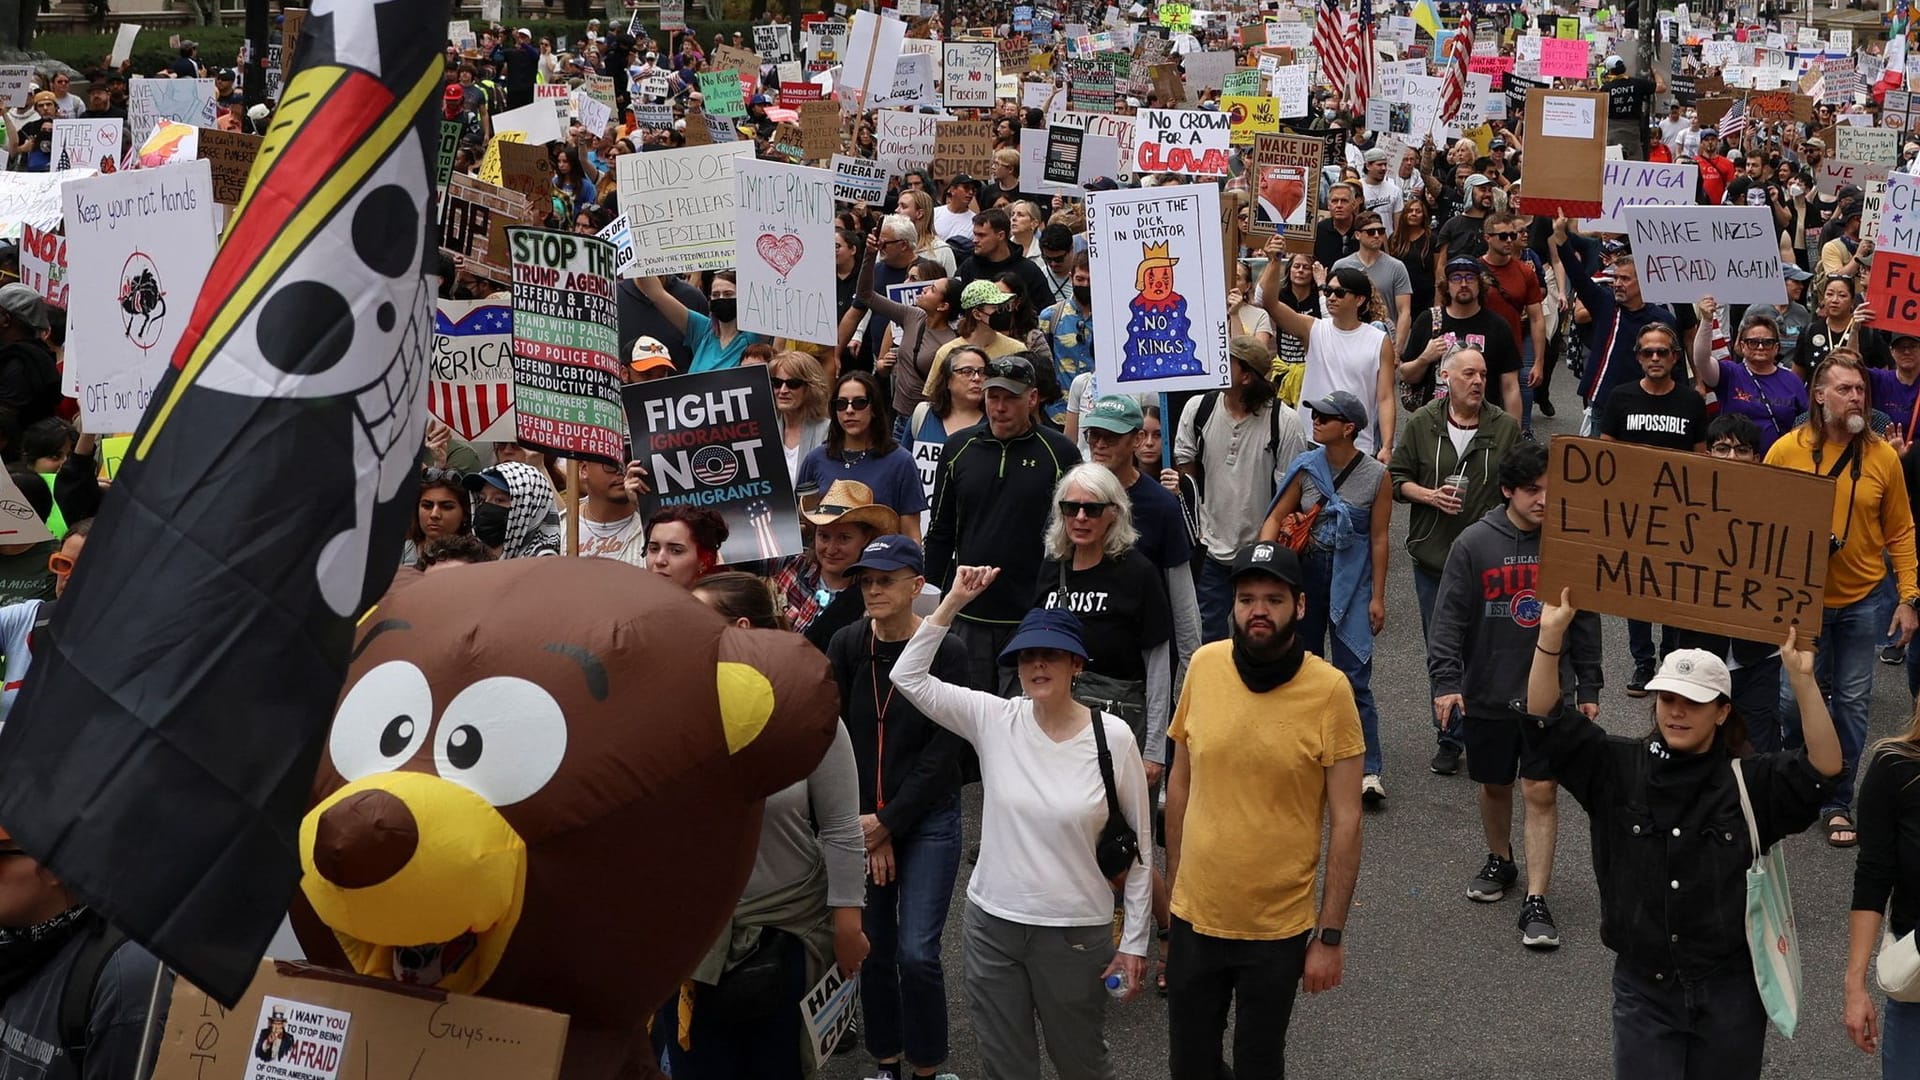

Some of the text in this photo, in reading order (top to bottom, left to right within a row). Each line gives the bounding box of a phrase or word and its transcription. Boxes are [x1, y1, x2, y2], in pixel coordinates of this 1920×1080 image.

[911, 44, 937, 54] HATE
[1073, 61, 1113, 70] STOP THE
[701, 71, 739, 87] No Kings
[947, 70, 992, 84] says NO to
[1224, 74, 1259, 89] CHICAGO
[537, 85, 568, 98] HATE
[783, 88, 821, 97] HANDS OFF
[949, 85, 988, 101] Fascism
[1611, 85, 1634, 96] DON'T
[133, 100, 150, 113] ME
[634, 105, 671, 113] HANDS OFF
[726, 101, 745, 113] 1776
[1257, 101, 1270, 115] NO
[637, 120, 673, 131] CHICAGO
[718, 121, 730, 132] DE
[883, 111, 917, 141] Keep
[1149, 111, 1231, 130] No CROWN
[56, 124, 92, 147] THE
[936, 123, 992, 138] DEMOCRACY
[1062, 134, 1081, 144] NATION
[1189, 130, 1203, 145] A
[1869, 130, 1887, 138] made
[938, 143, 986, 156] DIES IN
[1260, 138, 1319, 157] WAKE UP
[1856, 151, 1876, 161] ICE
[1053, 161, 1072, 171] UNDER
[1138, 141, 1230, 174] CLOWN
[1258, 153, 1319, 169] AMERICANS
[620, 156, 693, 195] HANDS
[837, 163, 887, 180] FUERA DE
[934, 160, 991, 177] SILENCE
[1048, 167, 1075, 178] DISTRESS
[1827, 165, 1855, 178] WE
[737, 170, 833, 226] IMMIGRANTS
[834, 184, 881, 203] CHICAGO
[77, 194, 102, 231] Keep
[108, 197, 135, 229] your
[161, 177, 197, 212] hands
[1109, 199, 1188, 218] YOU PUT THE
[759, 222, 799, 235] are the
[1087, 193, 1099, 259] JOKER
[1136, 216, 1164, 228] DICK
[1114, 224, 1185, 241] IN DICTATOR
[1636, 219, 1764, 245] MAKE NAZIS
[513, 231, 615, 282] STOP THE
[678, 263, 695, 273] THE
[1646, 253, 1780, 285] AFRAID AGAIN!
[513, 263, 616, 302] TRUMP AGENDA
[513, 283, 560, 304] DEFEND
[567, 293, 576, 306] &
[901, 287, 919, 306] ICE
[513, 297, 583, 320] IMMIGRANT
[744, 280, 833, 338] AMERICA
[514, 312, 575, 334] STAND WITH
[1144, 315, 1168, 330] NO
[514, 325, 593, 349] END US AID TO
[514, 340, 541, 356] STOP
[545, 346, 589, 364] POLICE
[1137, 338, 1184, 356] KINGS
[514, 356, 609, 385] DEFEND LGBTQIA+
[514, 371, 595, 396] REPRODUCTIVE
[86, 382, 110, 413] OFF
[114, 388, 132, 410] our
[515, 384, 544, 402] DEFEND
[546, 393, 591, 410] WORKERS'
[516, 399, 586, 422] UNIONIZE &
[644, 386, 752, 433] FIGHT
[517, 412, 618, 446] DEFEND EDUCATION
[1626, 413, 1689, 436] IMPOSSIBLE
[517, 427, 574, 449] ACADEMIC
[650, 421, 760, 451] IGNORANCE
[651, 438, 764, 495] NOT
[1563, 443, 1732, 513] DO ALL
[660, 479, 772, 507] IMMIGRANTS
[1561, 498, 1823, 590] LIVES STILL
[1595, 550, 1814, 626] MATTER??
[1045, 591, 1108, 613] RSIST.
[289, 1009, 347, 1031] I WANT YOU
[287, 1023, 343, 1043] TO STOP BEING
[288, 1039, 338, 1073] AFRAID
[256, 1063, 287, 1077] OF OTHER
